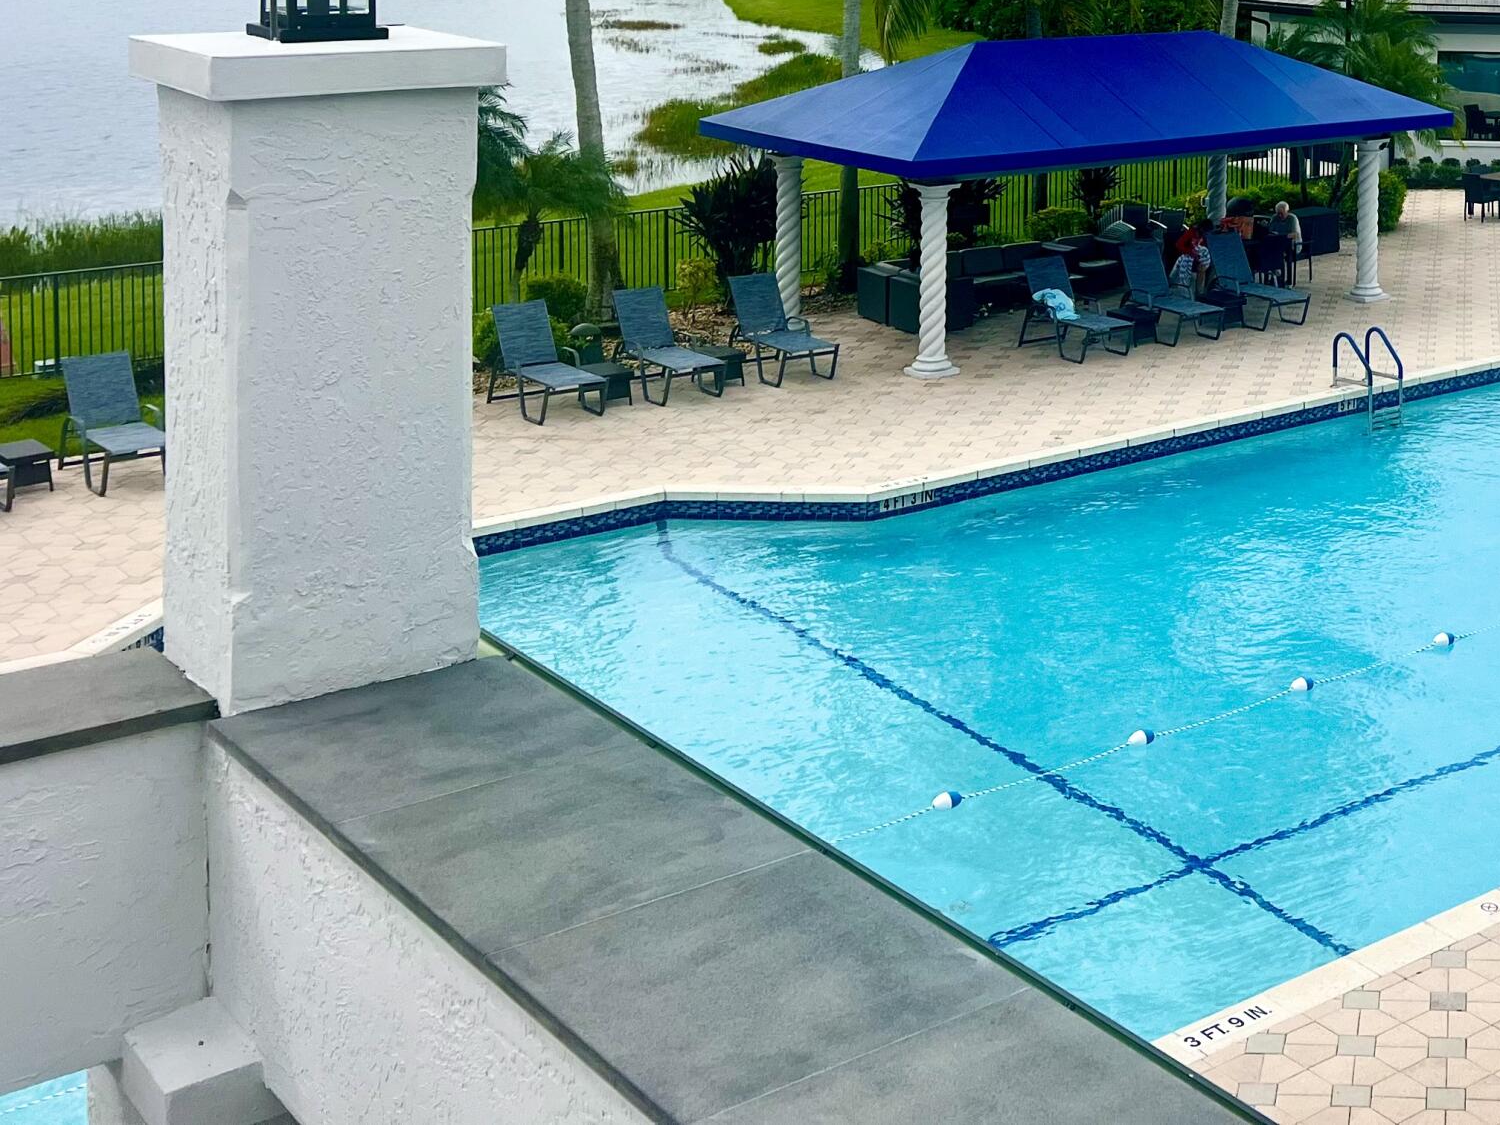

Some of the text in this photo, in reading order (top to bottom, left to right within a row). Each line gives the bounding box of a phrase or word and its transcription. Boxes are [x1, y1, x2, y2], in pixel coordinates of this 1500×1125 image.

[1340, 400, 1345, 411] 5
[883, 489, 934, 511] 4 FT 3 IN
[1183, 1005, 1273, 1048] 3 FT. 9 IN.
